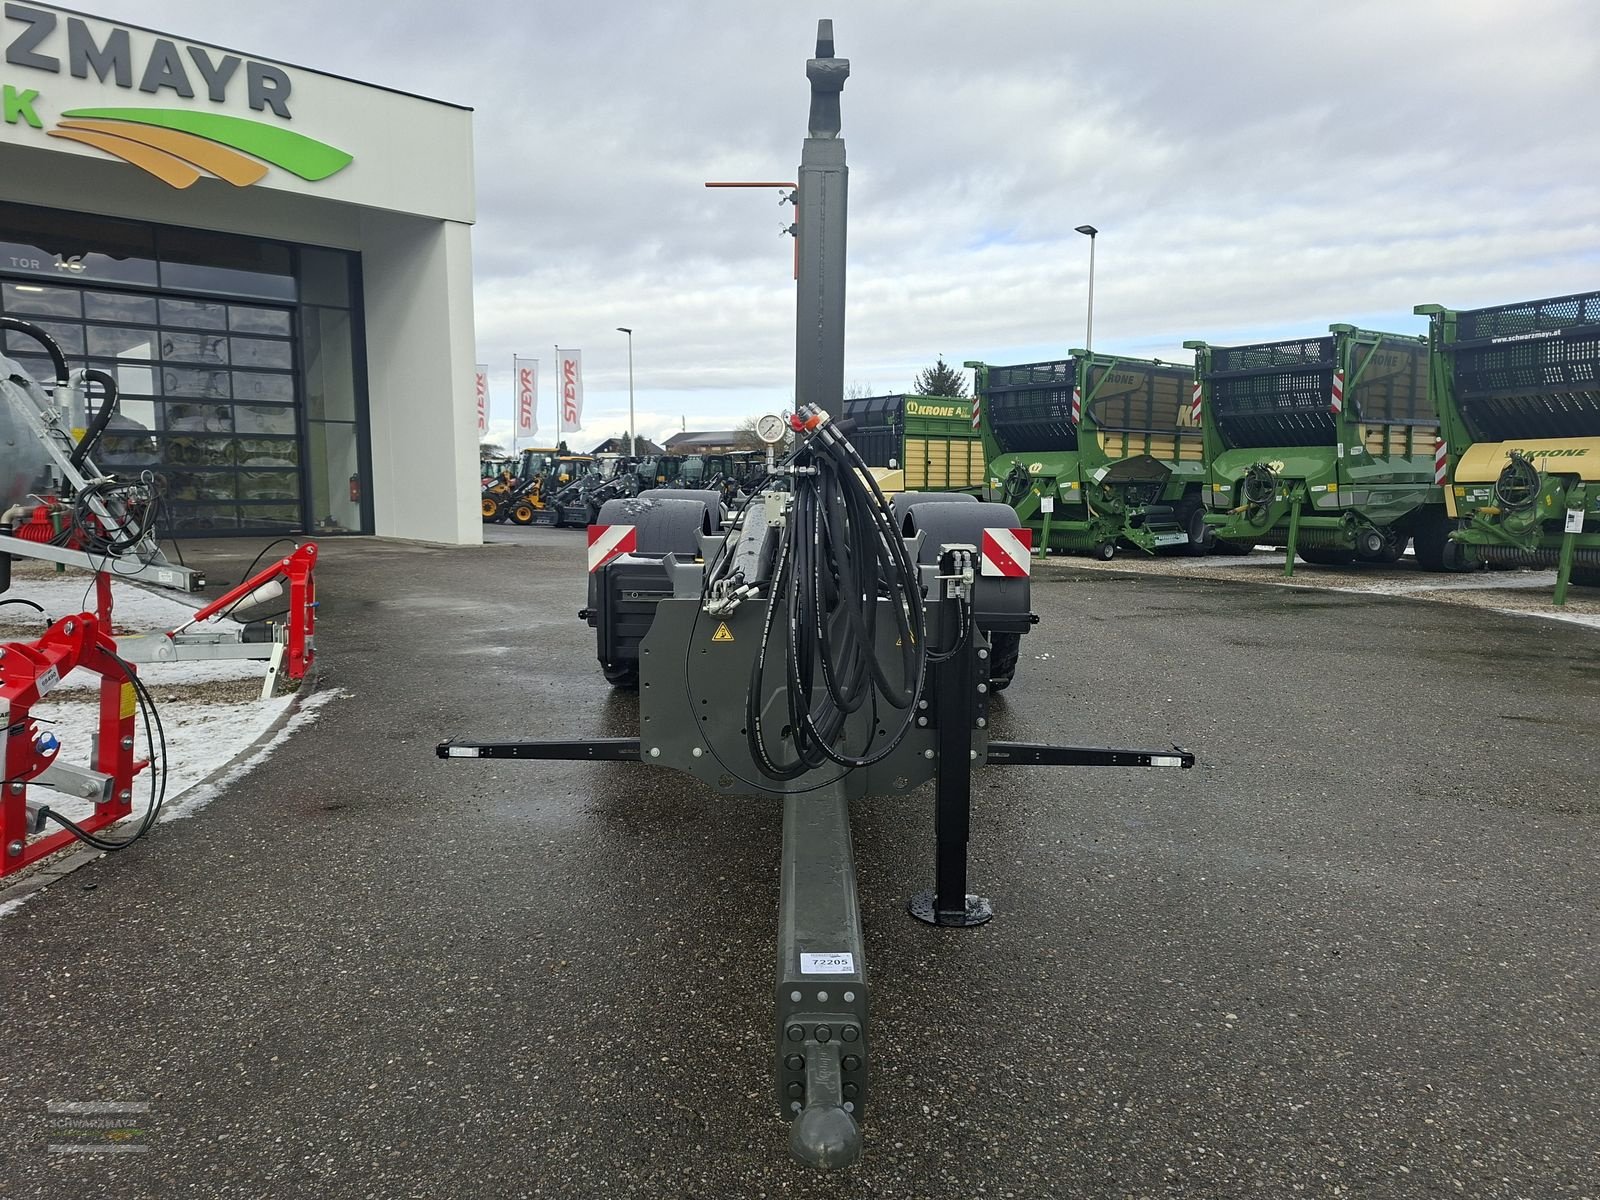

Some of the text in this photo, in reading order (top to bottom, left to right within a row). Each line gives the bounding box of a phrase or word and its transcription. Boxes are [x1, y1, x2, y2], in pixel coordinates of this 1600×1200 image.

[3, 84, 43, 129] K
[10, 253, 85, 274] TOR 16
[1492, 329, 1561, 344] www.schwarzmayr.at
[521, 368, 532, 430] STEYR
[564, 360, 576, 424] STEYR
[918, 405, 954, 417] KRONE
[1524, 448, 1590, 458] KRONE
